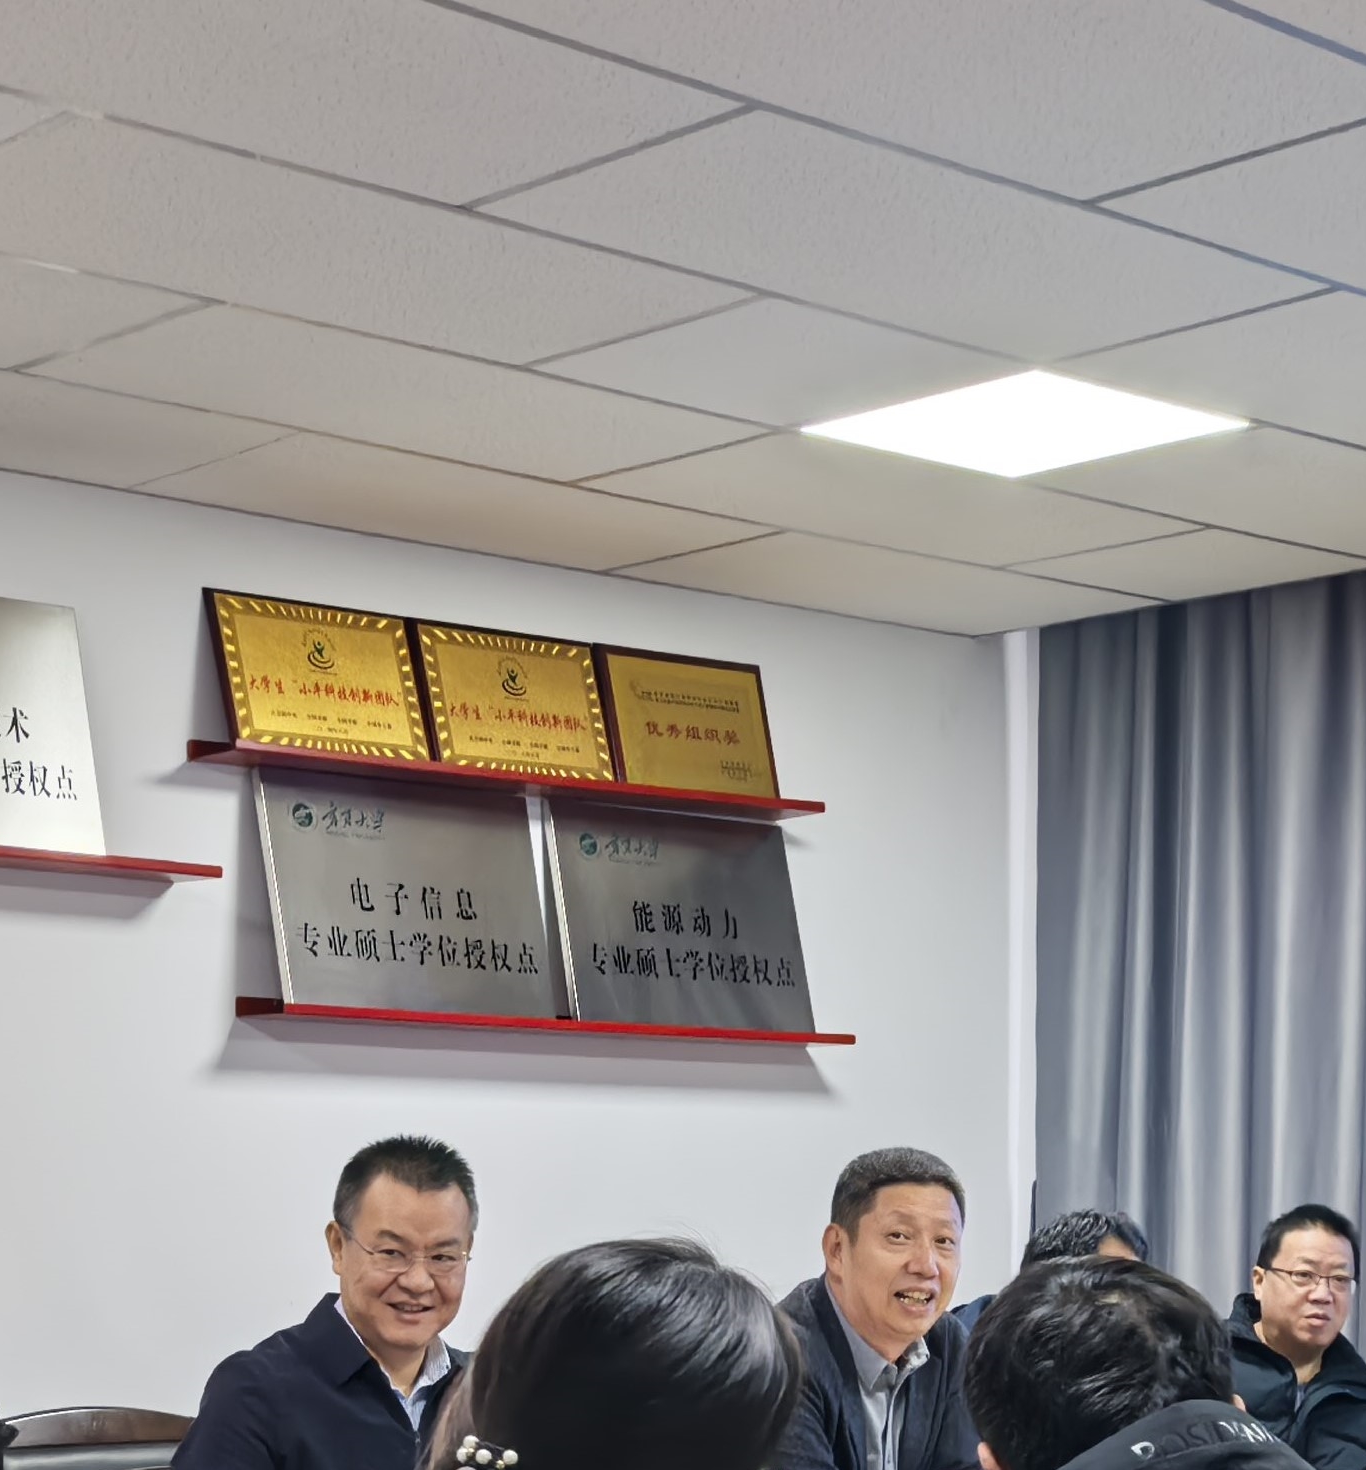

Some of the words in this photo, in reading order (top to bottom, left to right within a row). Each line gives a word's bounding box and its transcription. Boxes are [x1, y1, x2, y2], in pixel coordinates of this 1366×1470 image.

[349, 876, 480, 922] 电子信息
[632, 899, 740, 938] 能源动力
[296, 921, 540, 976] 专业硕士学位授权点
[590, 942, 796, 989] 专业硕士学位授权点
